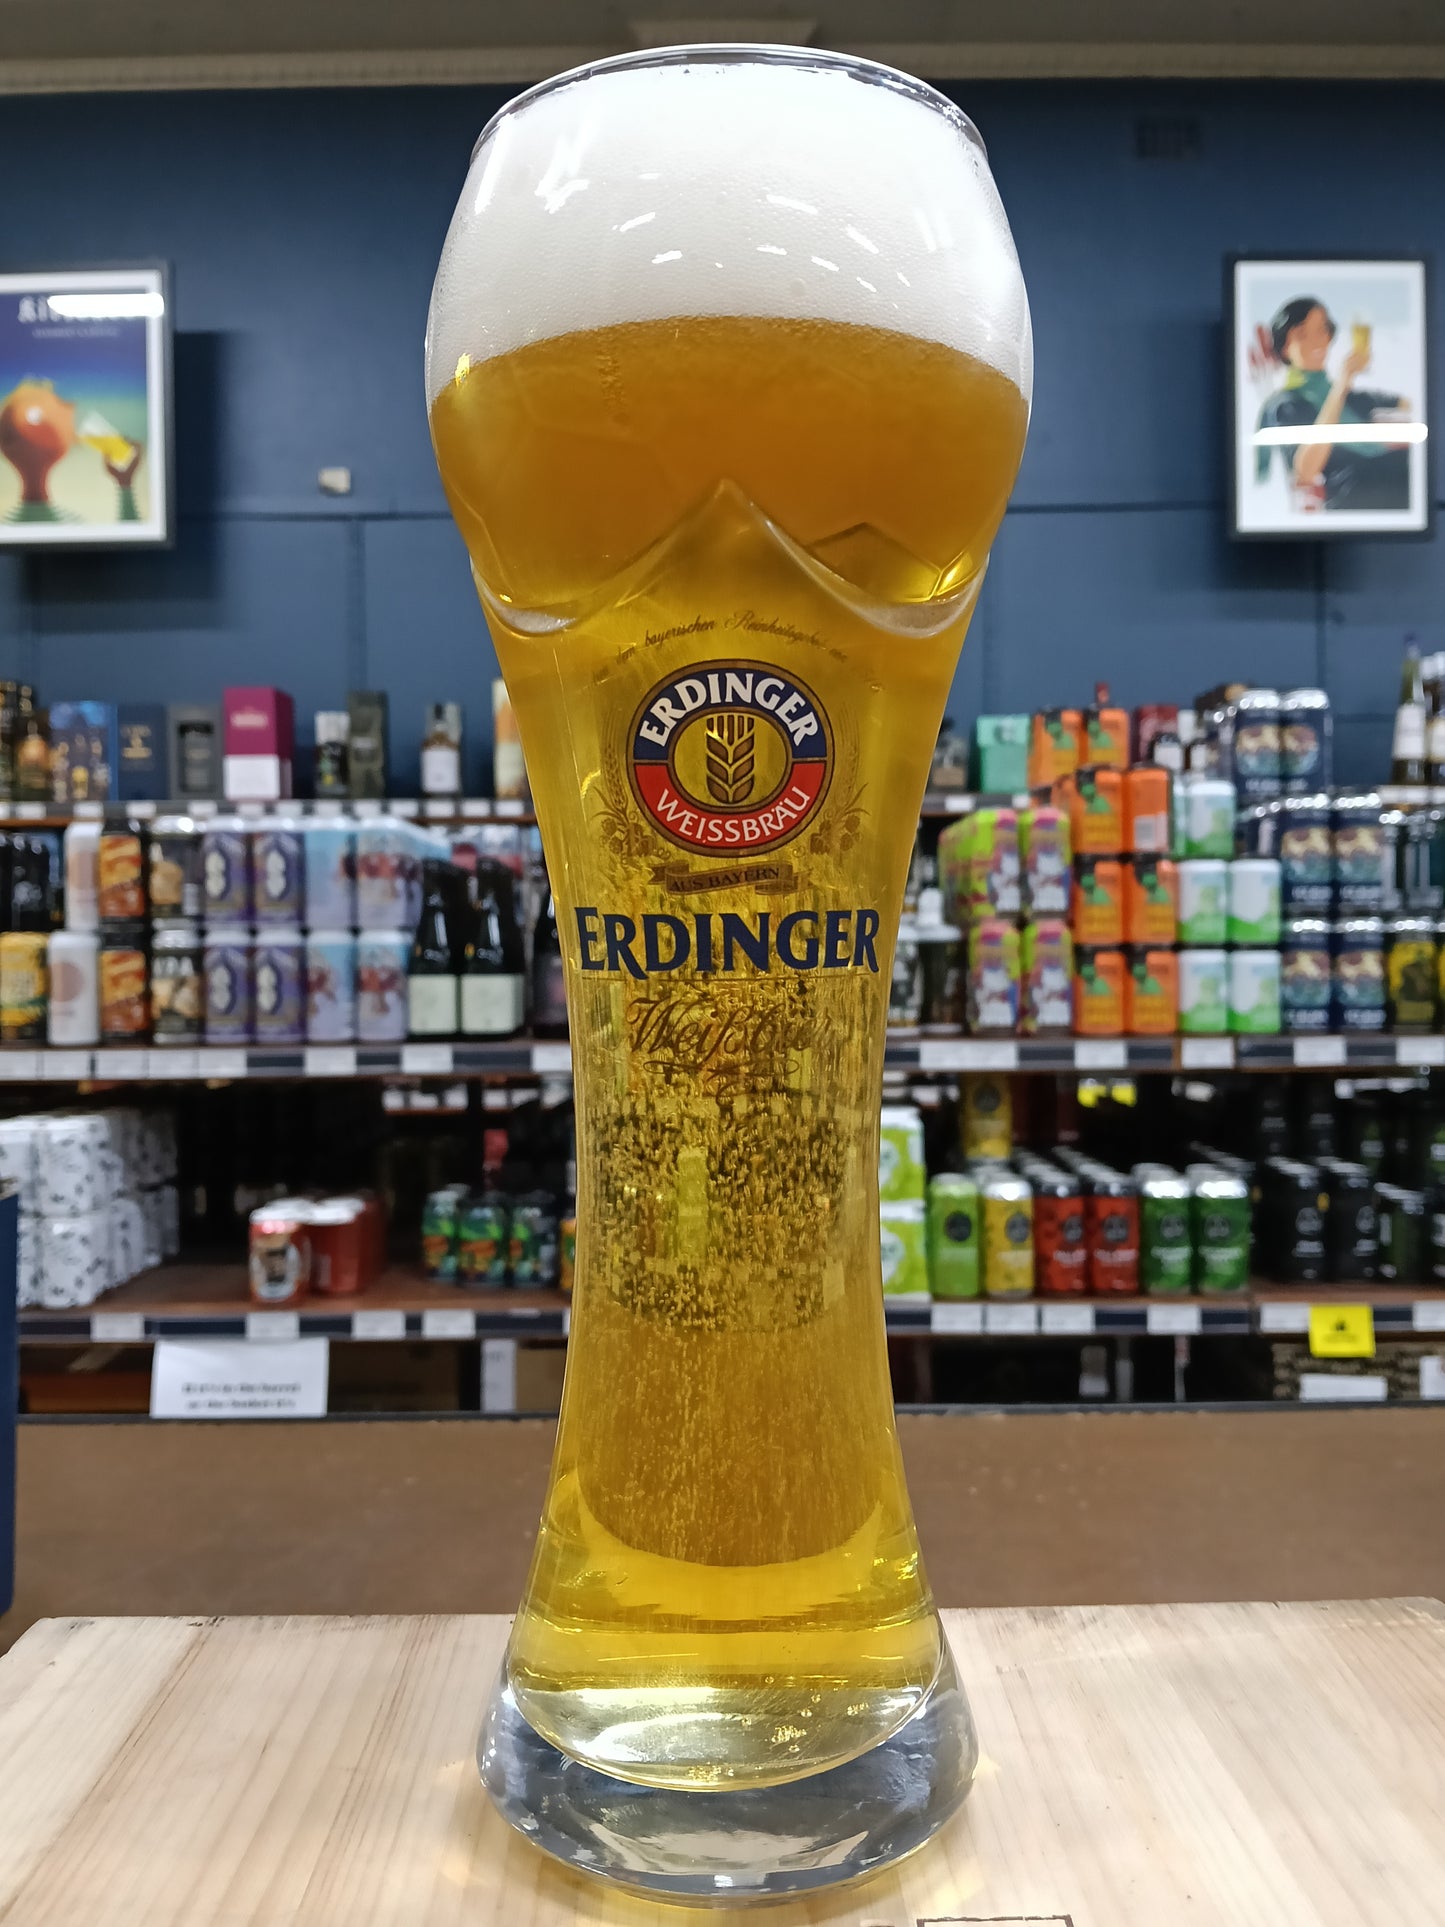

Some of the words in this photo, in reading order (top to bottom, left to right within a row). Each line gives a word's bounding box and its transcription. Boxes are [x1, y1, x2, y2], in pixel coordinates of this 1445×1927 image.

[644, 615, 714, 646] bayerischen
[640, 672, 819, 748] ERDINGER
[656, 786, 811, 844] WEISSBRÄU
[669, 878, 704, 893] AUS
[708, 867, 781, 889] BAYERN
[574, 906, 880, 980] ERDINGER
